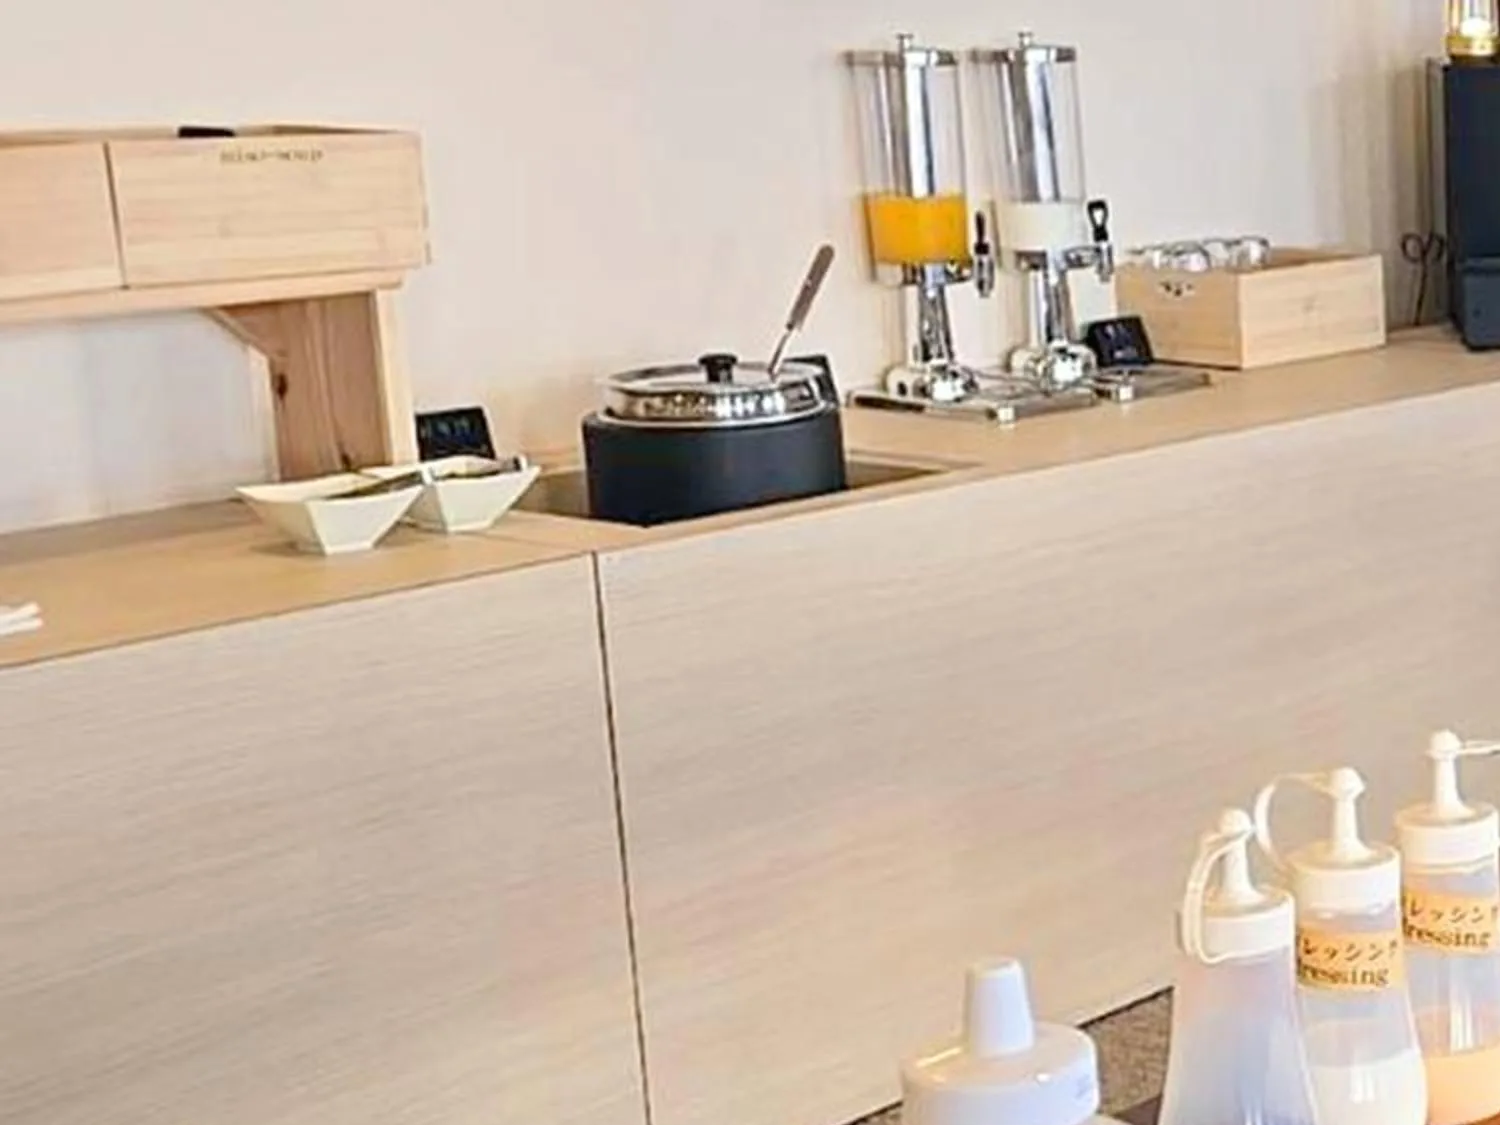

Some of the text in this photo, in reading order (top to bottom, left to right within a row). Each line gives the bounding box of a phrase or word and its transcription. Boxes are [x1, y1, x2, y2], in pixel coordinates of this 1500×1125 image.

[1402, 898, 1498, 924] レッシン
[1297, 936, 1398, 961] レッシン
